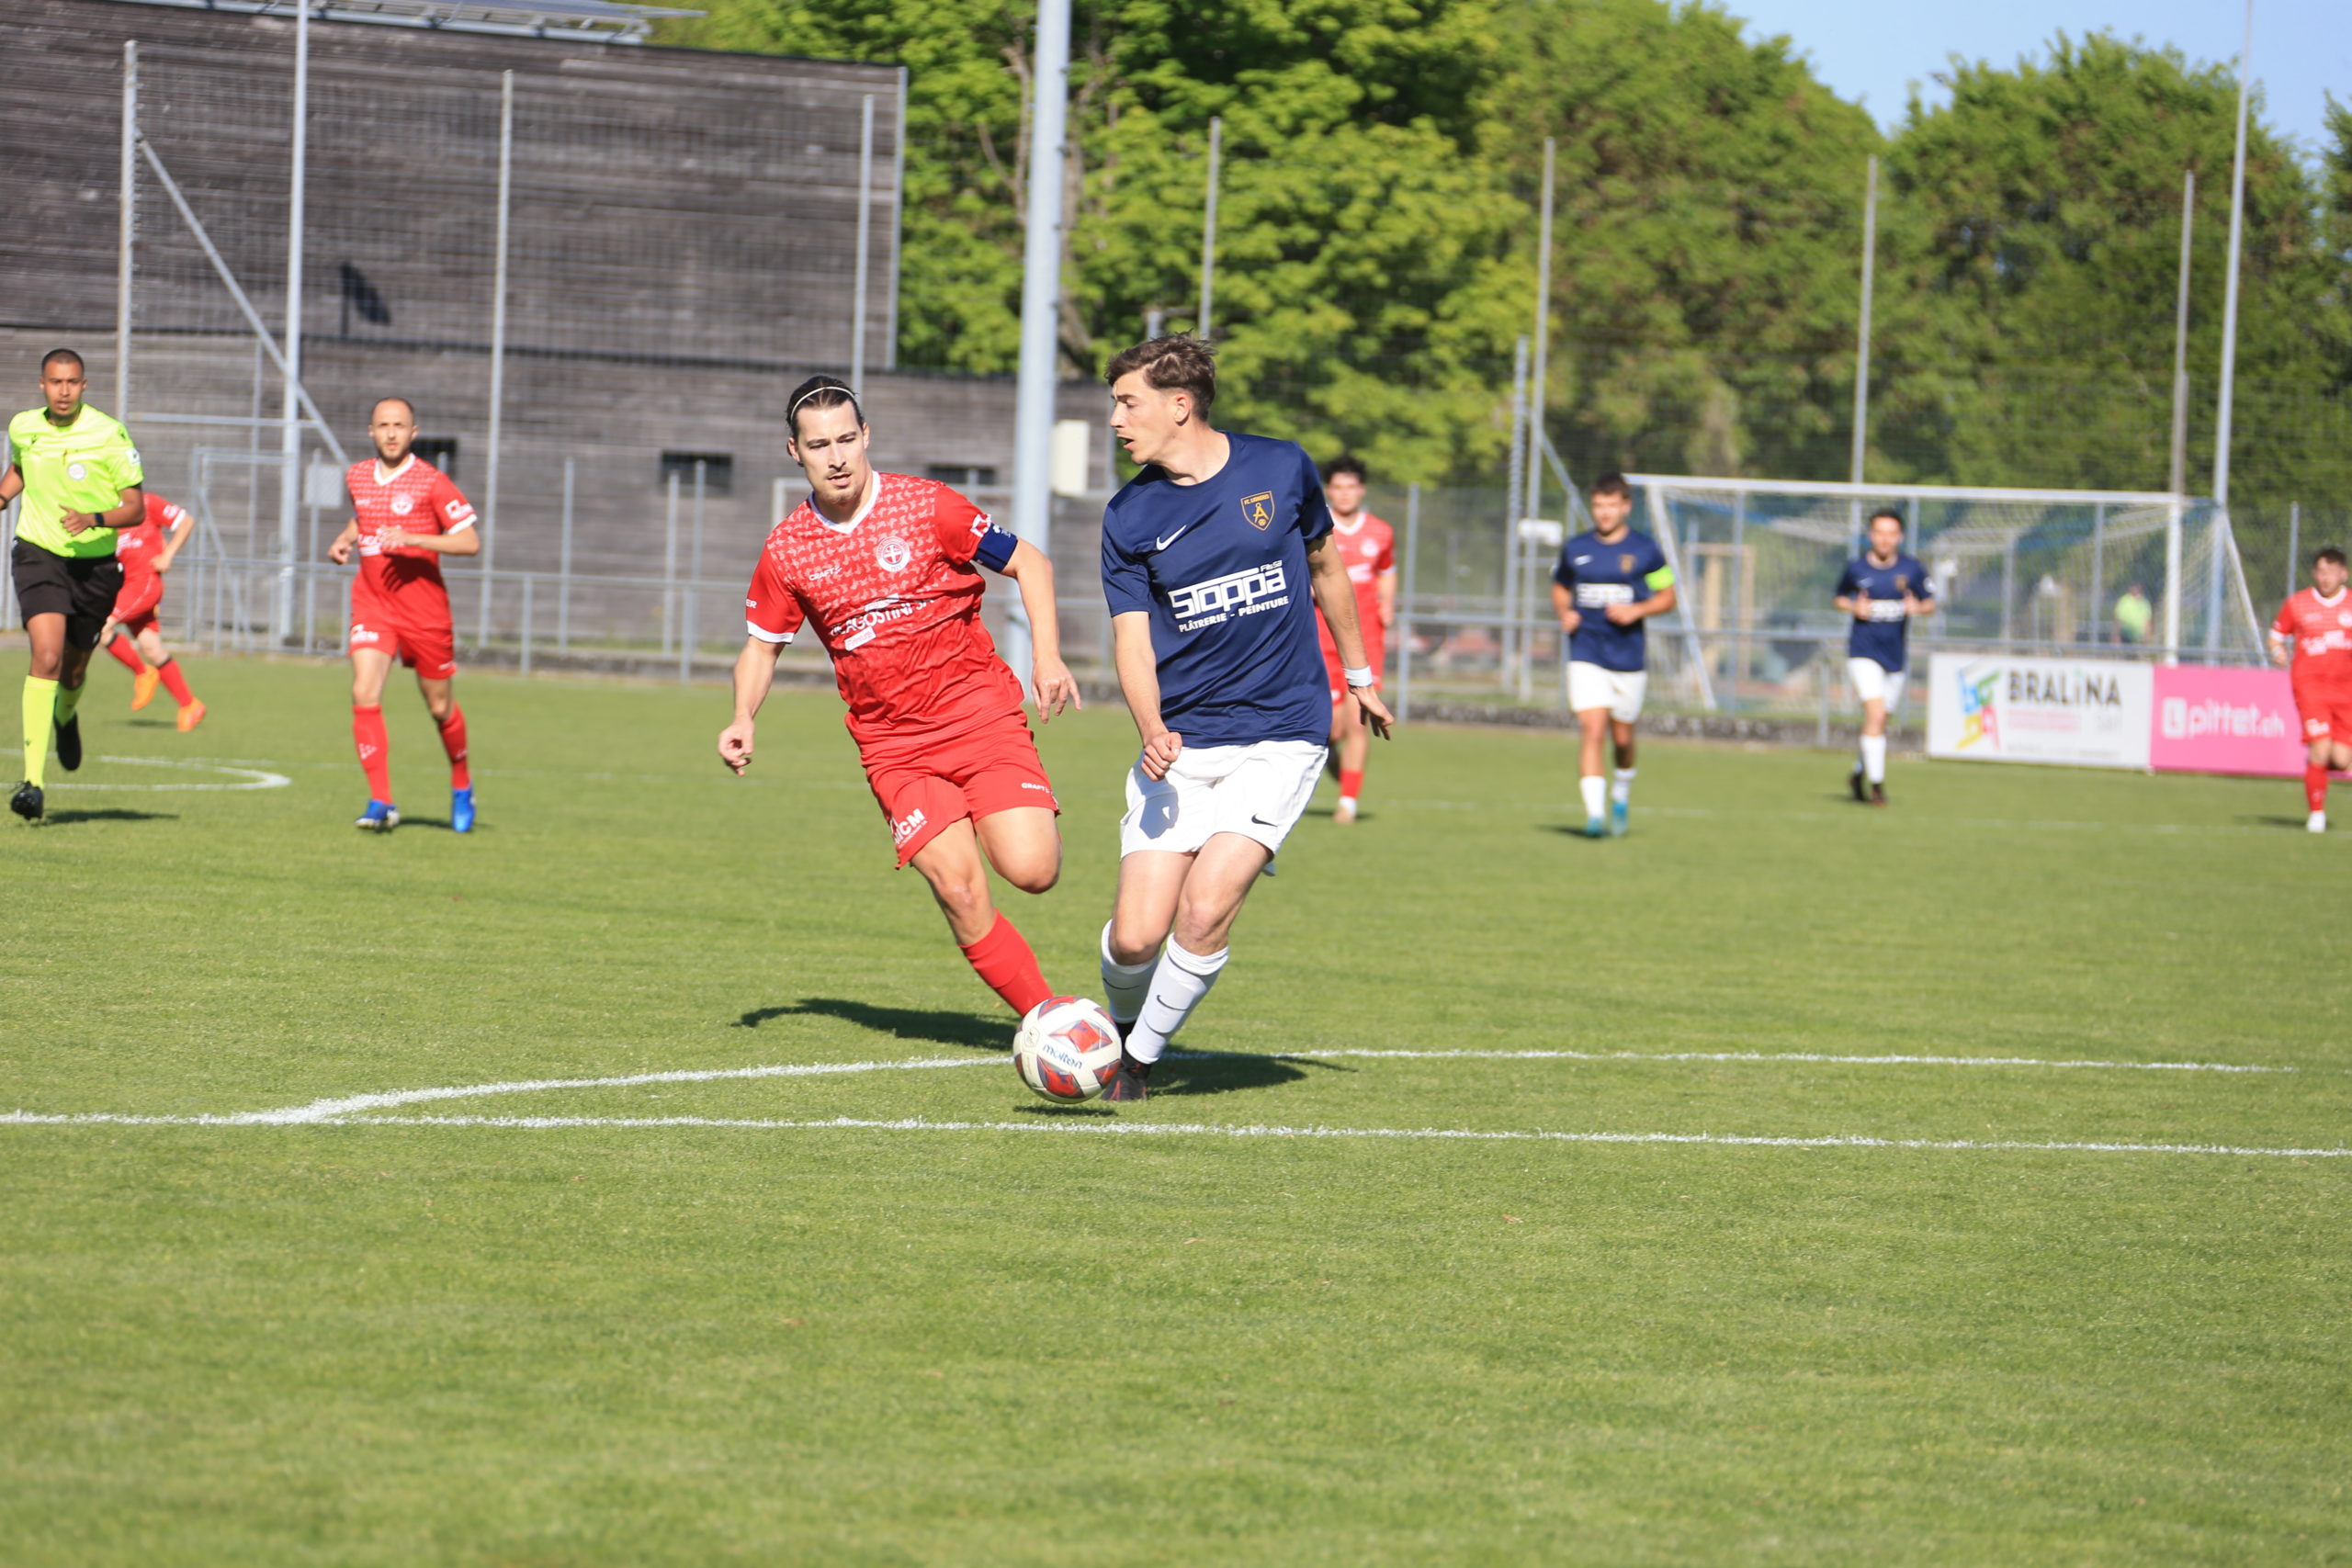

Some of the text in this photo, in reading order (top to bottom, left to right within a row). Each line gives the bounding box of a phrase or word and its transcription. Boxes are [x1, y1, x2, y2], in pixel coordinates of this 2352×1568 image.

[808, 566, 835, 581] CRAFT
[1178, 612, 1227, 633] PLÂTRERIE
[1238, 595, 1289, 616] PEINTURE
[1021, 782, 1045, 792] CRAFT
[1042, 1043, 1082, 1070] molten
